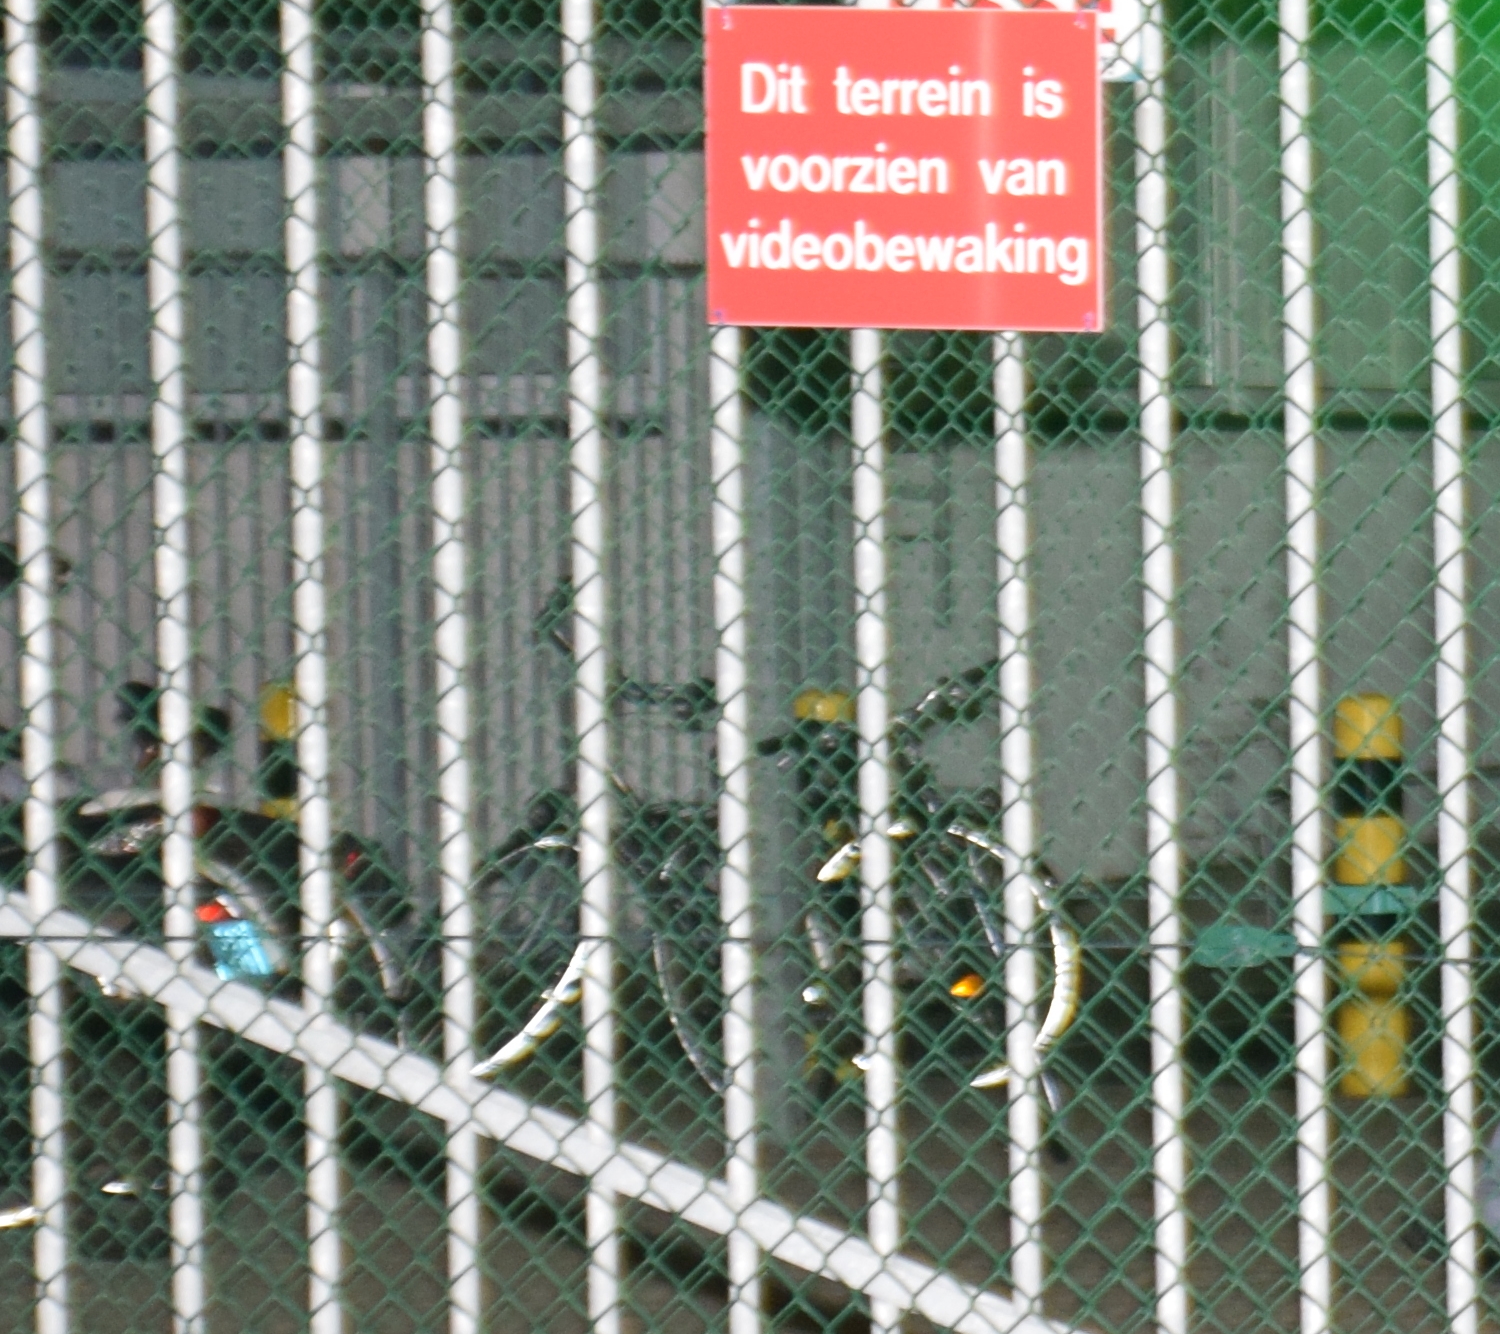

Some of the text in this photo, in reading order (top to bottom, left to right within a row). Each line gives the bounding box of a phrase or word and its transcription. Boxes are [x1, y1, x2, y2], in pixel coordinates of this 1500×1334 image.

[740, 62, 1066, 119] Dit terrein is
[740, 142, 1068, 197] voorzien van
[719, 217, 1090, 286] videobewaking
